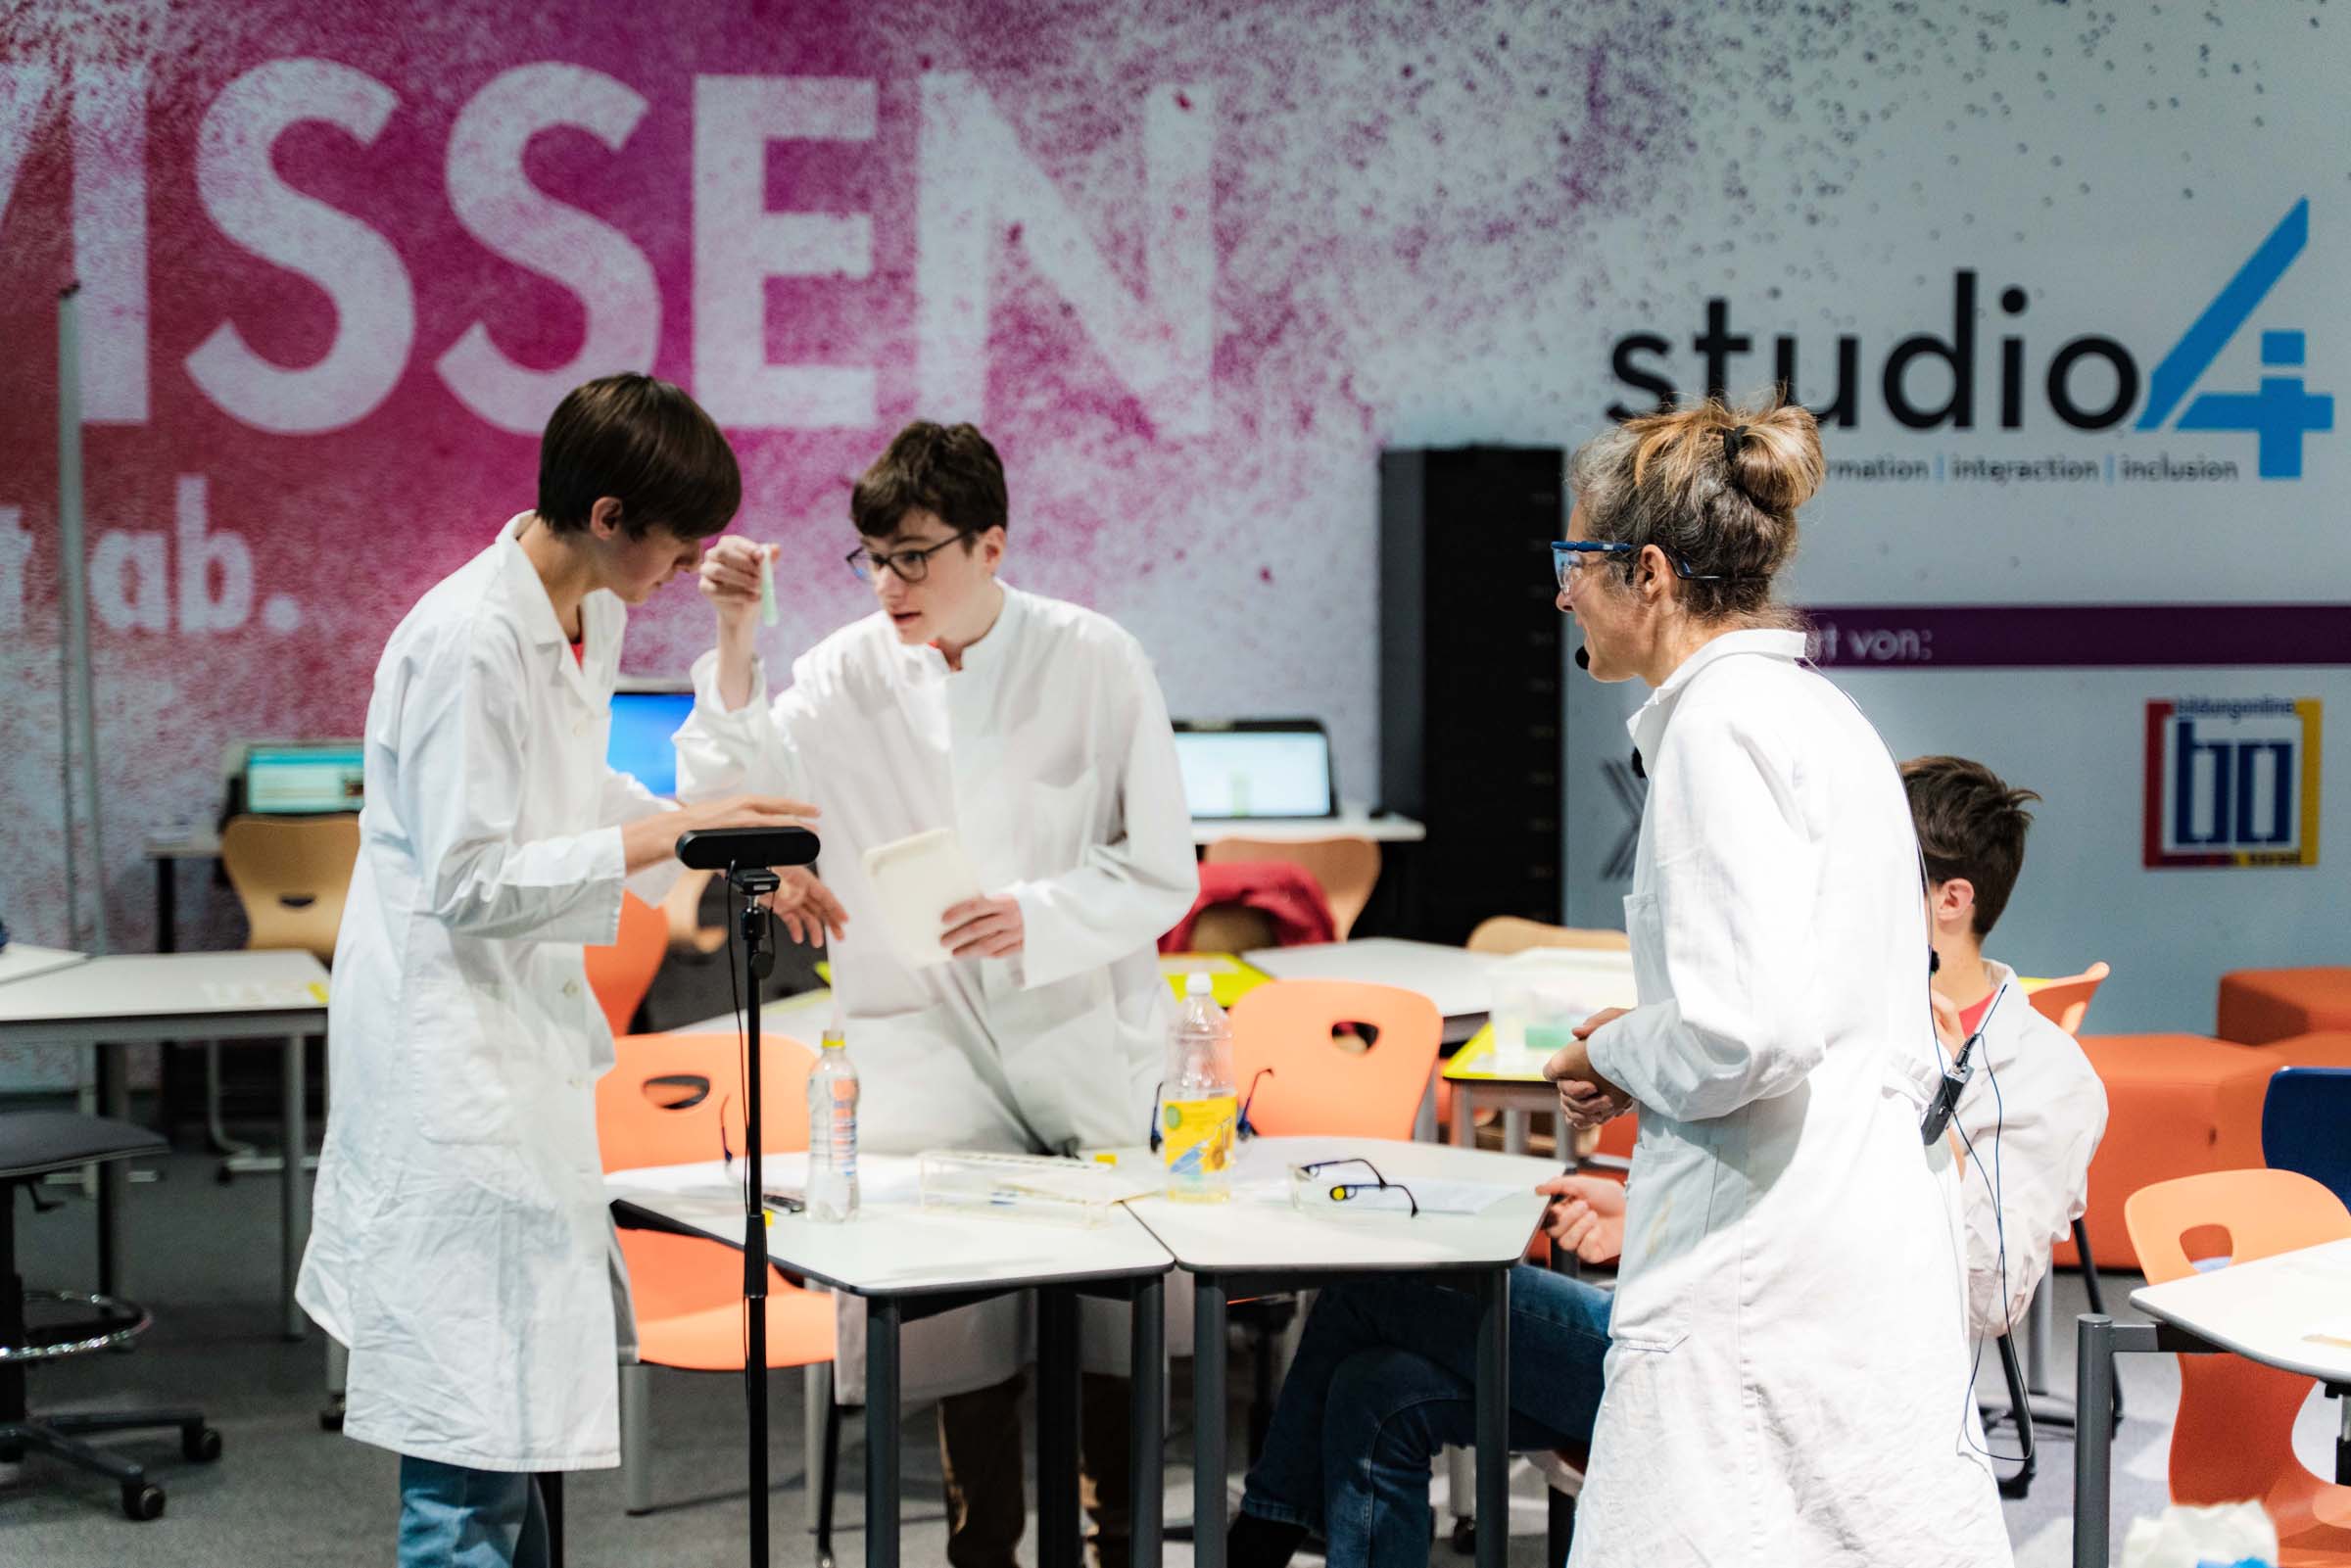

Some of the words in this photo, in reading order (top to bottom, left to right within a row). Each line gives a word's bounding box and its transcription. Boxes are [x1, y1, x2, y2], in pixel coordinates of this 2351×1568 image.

[0, 56, 1214, 437] ISSEN
[2122, 451, 2239, 480] inclusion
[89, 473, 301, 633] ab.
[1847, 628, 1934, 660] von:
